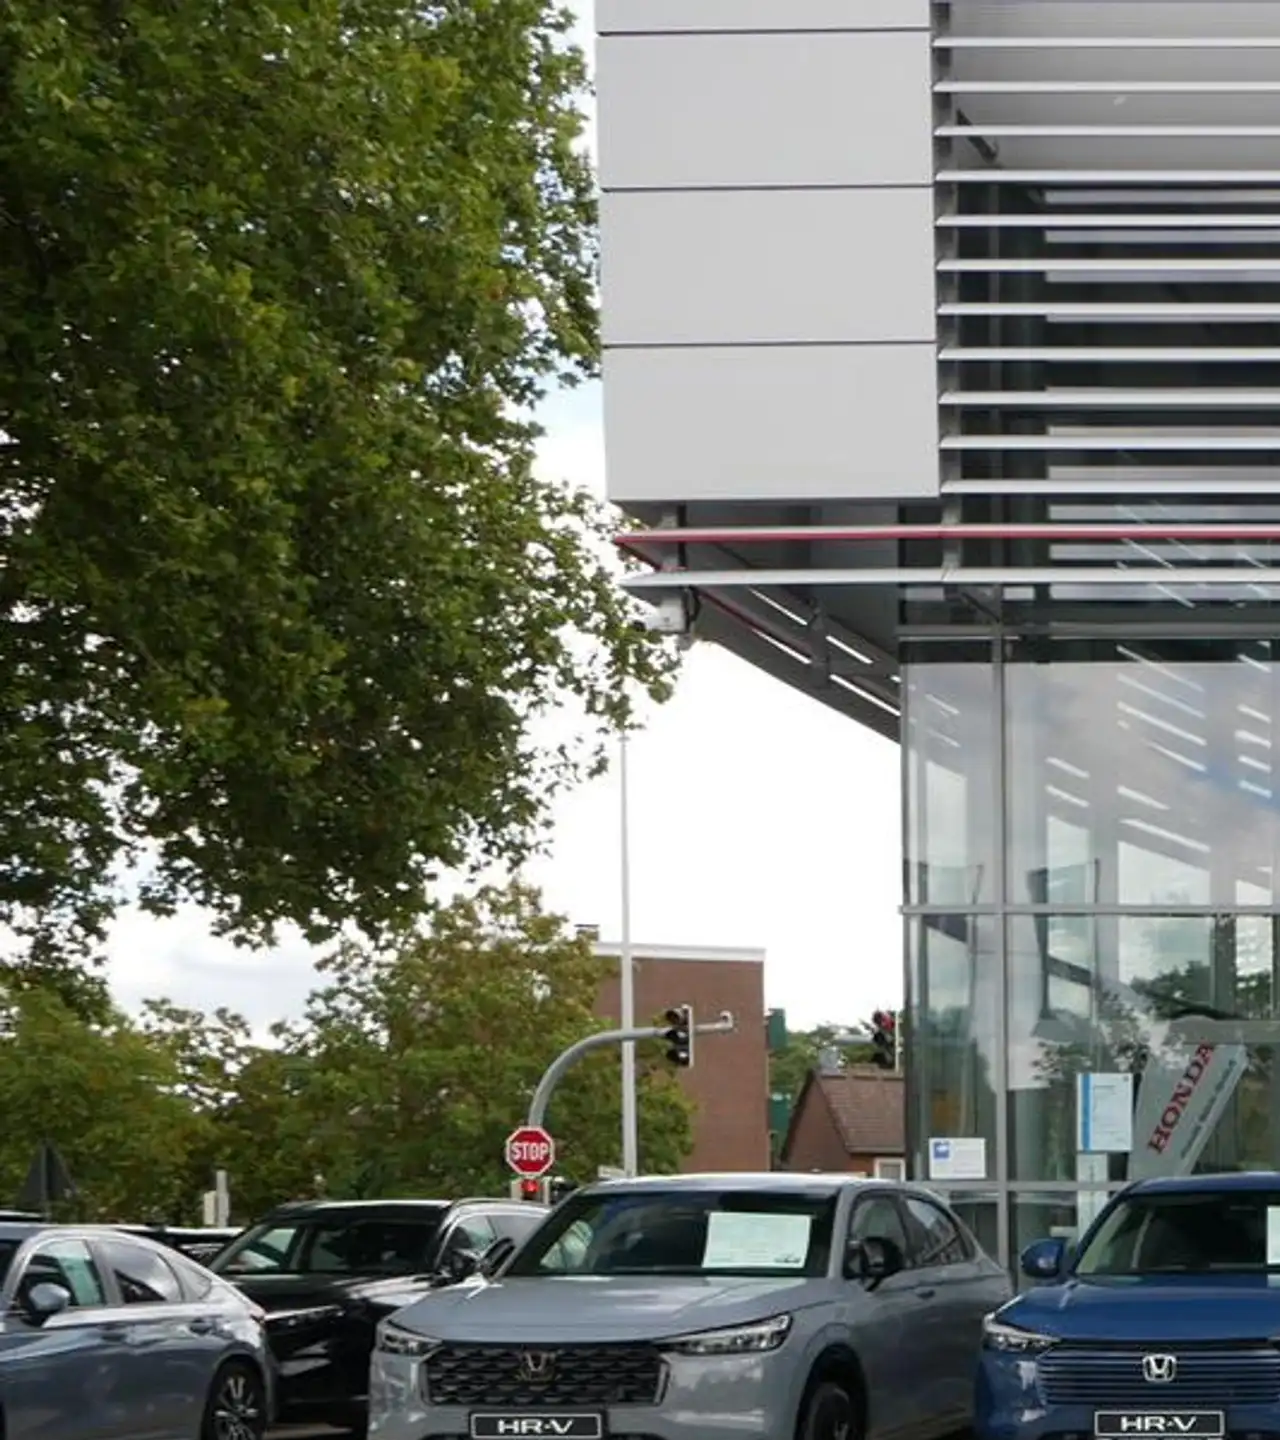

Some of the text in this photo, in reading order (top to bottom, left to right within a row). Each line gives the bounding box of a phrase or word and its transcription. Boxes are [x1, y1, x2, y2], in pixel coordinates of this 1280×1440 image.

[1148, 1038, 1214, 1153] HONDA
[511, 1141, 549, 1161] STOP
[497, 1418, 573, 1434] HR-V
[1120, 1415, 1197, 1431] HR-V
